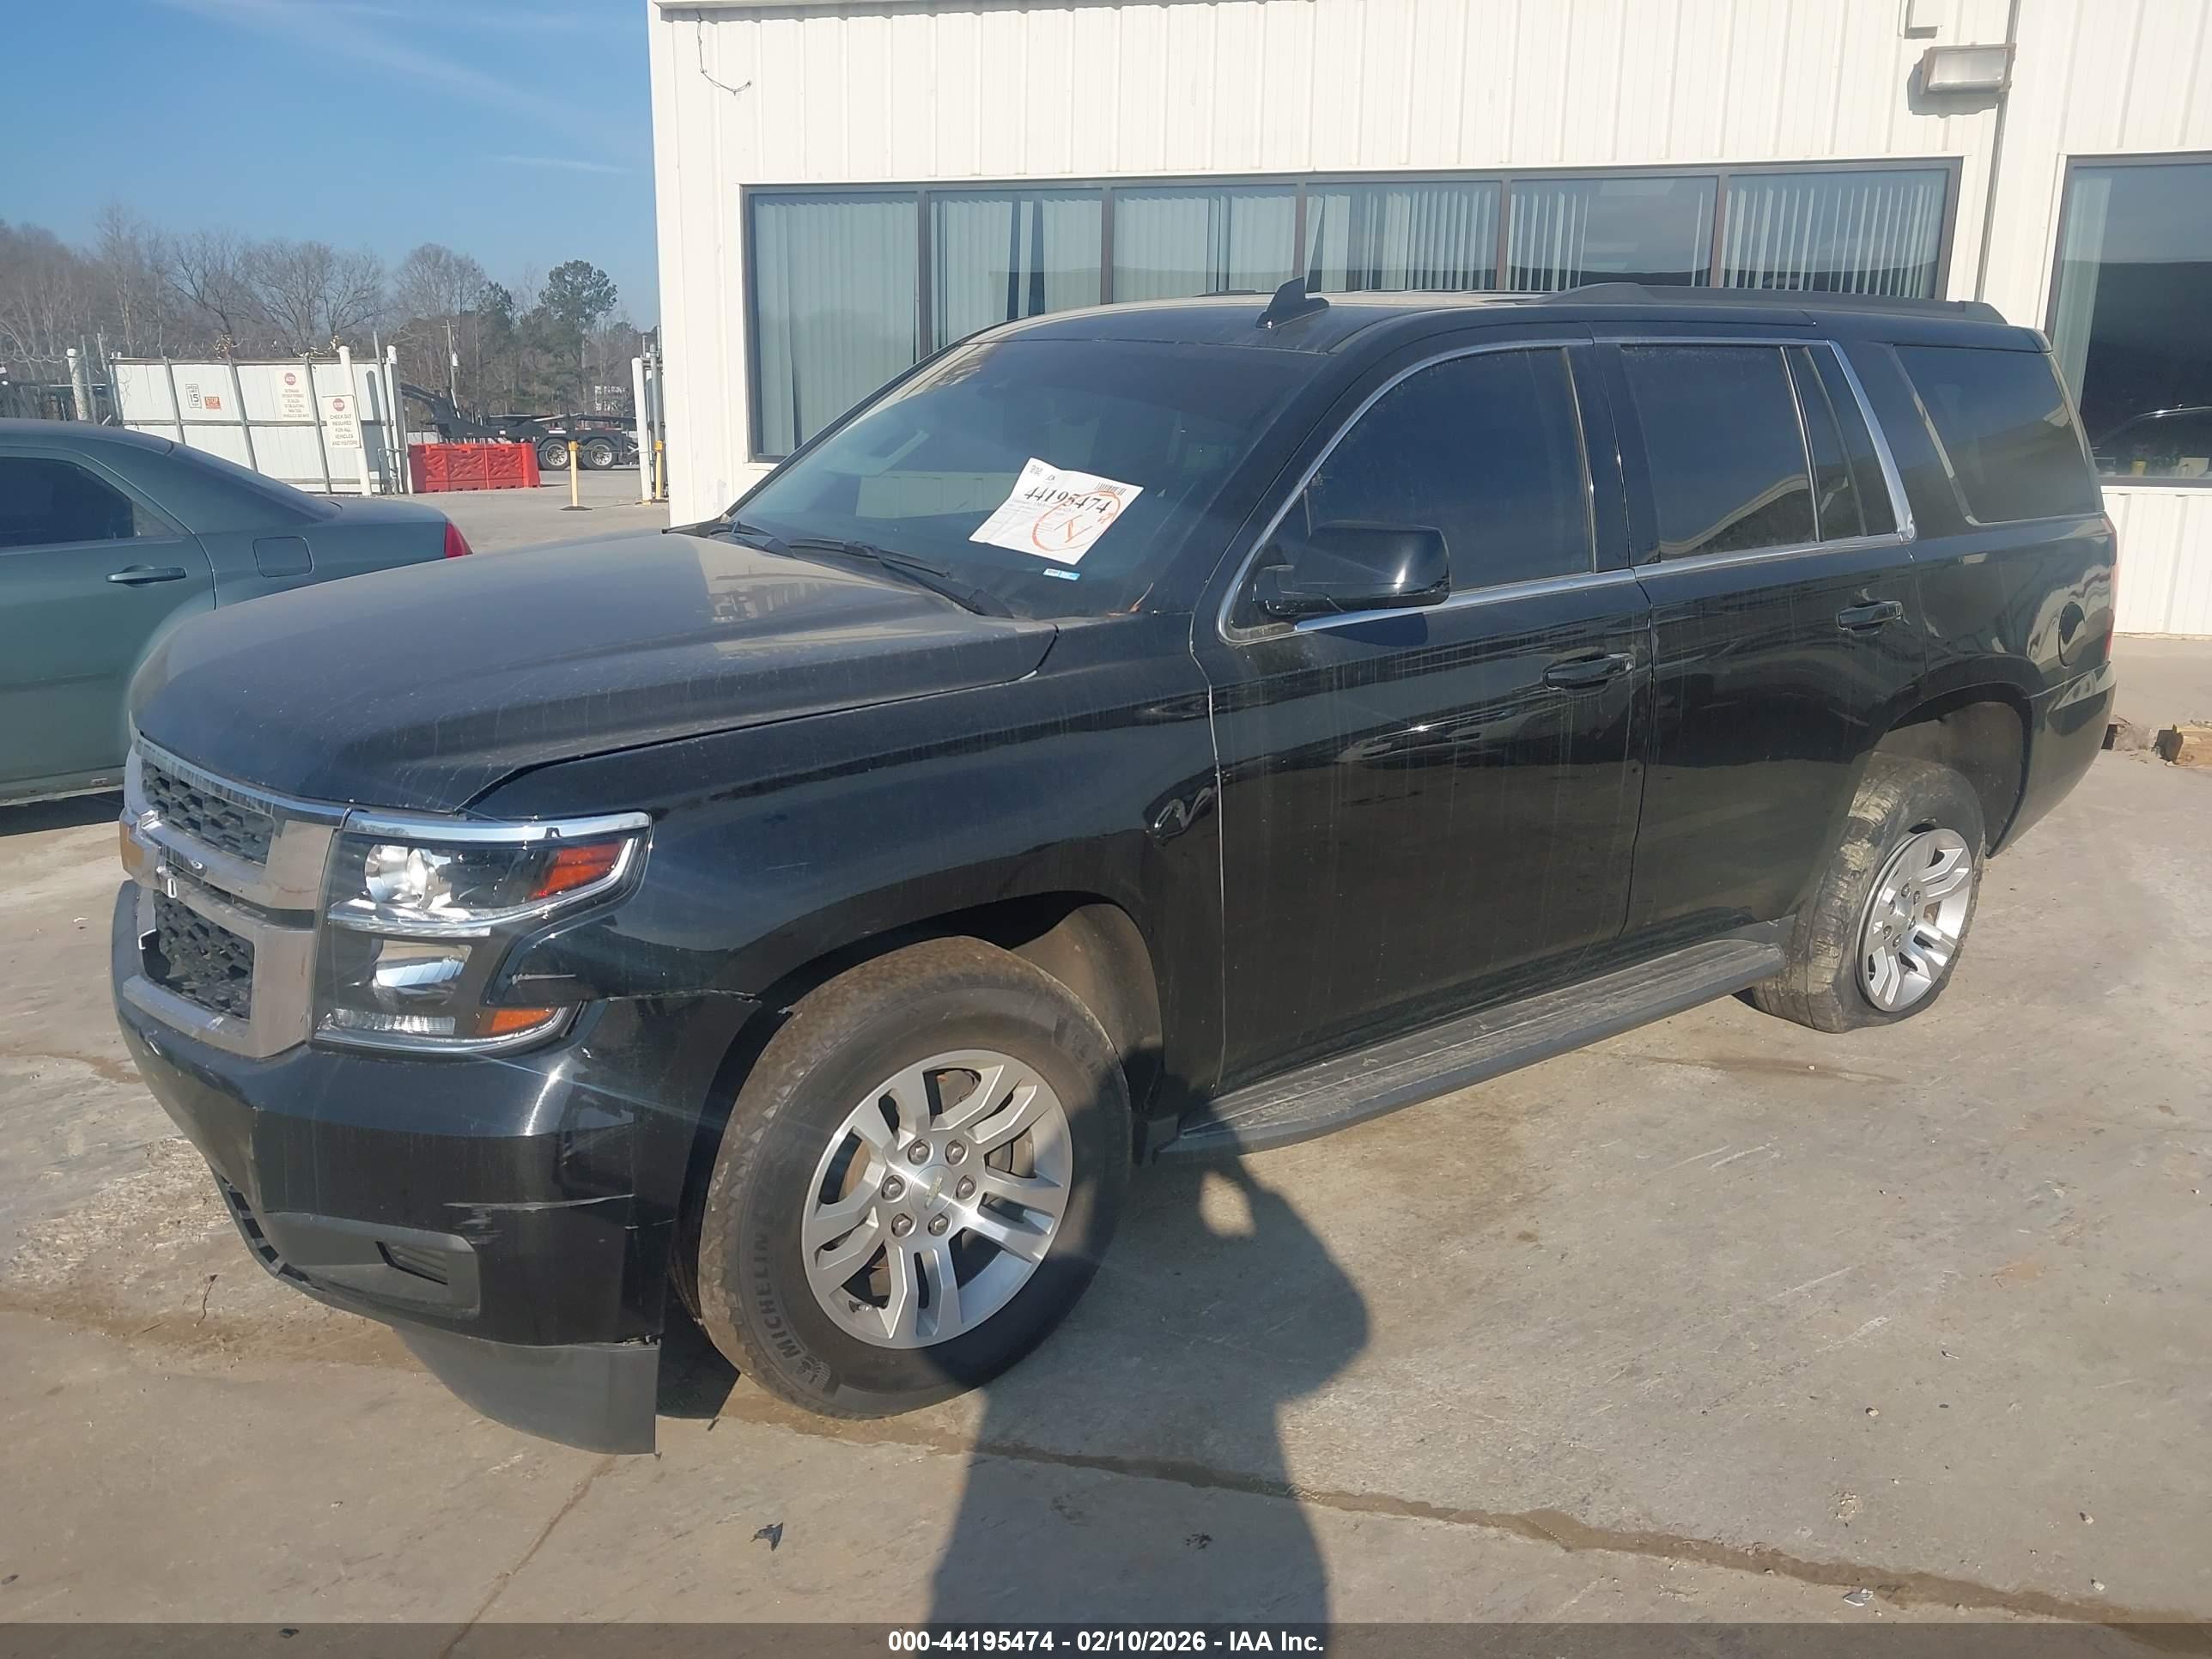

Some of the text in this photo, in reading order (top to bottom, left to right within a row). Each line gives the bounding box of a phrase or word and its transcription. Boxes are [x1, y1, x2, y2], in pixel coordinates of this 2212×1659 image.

[190, 393, 199, 403] 15
[1024, 486, 1113, 514] 44195474
[754, 1233, 801, 1359] MICHELIN
